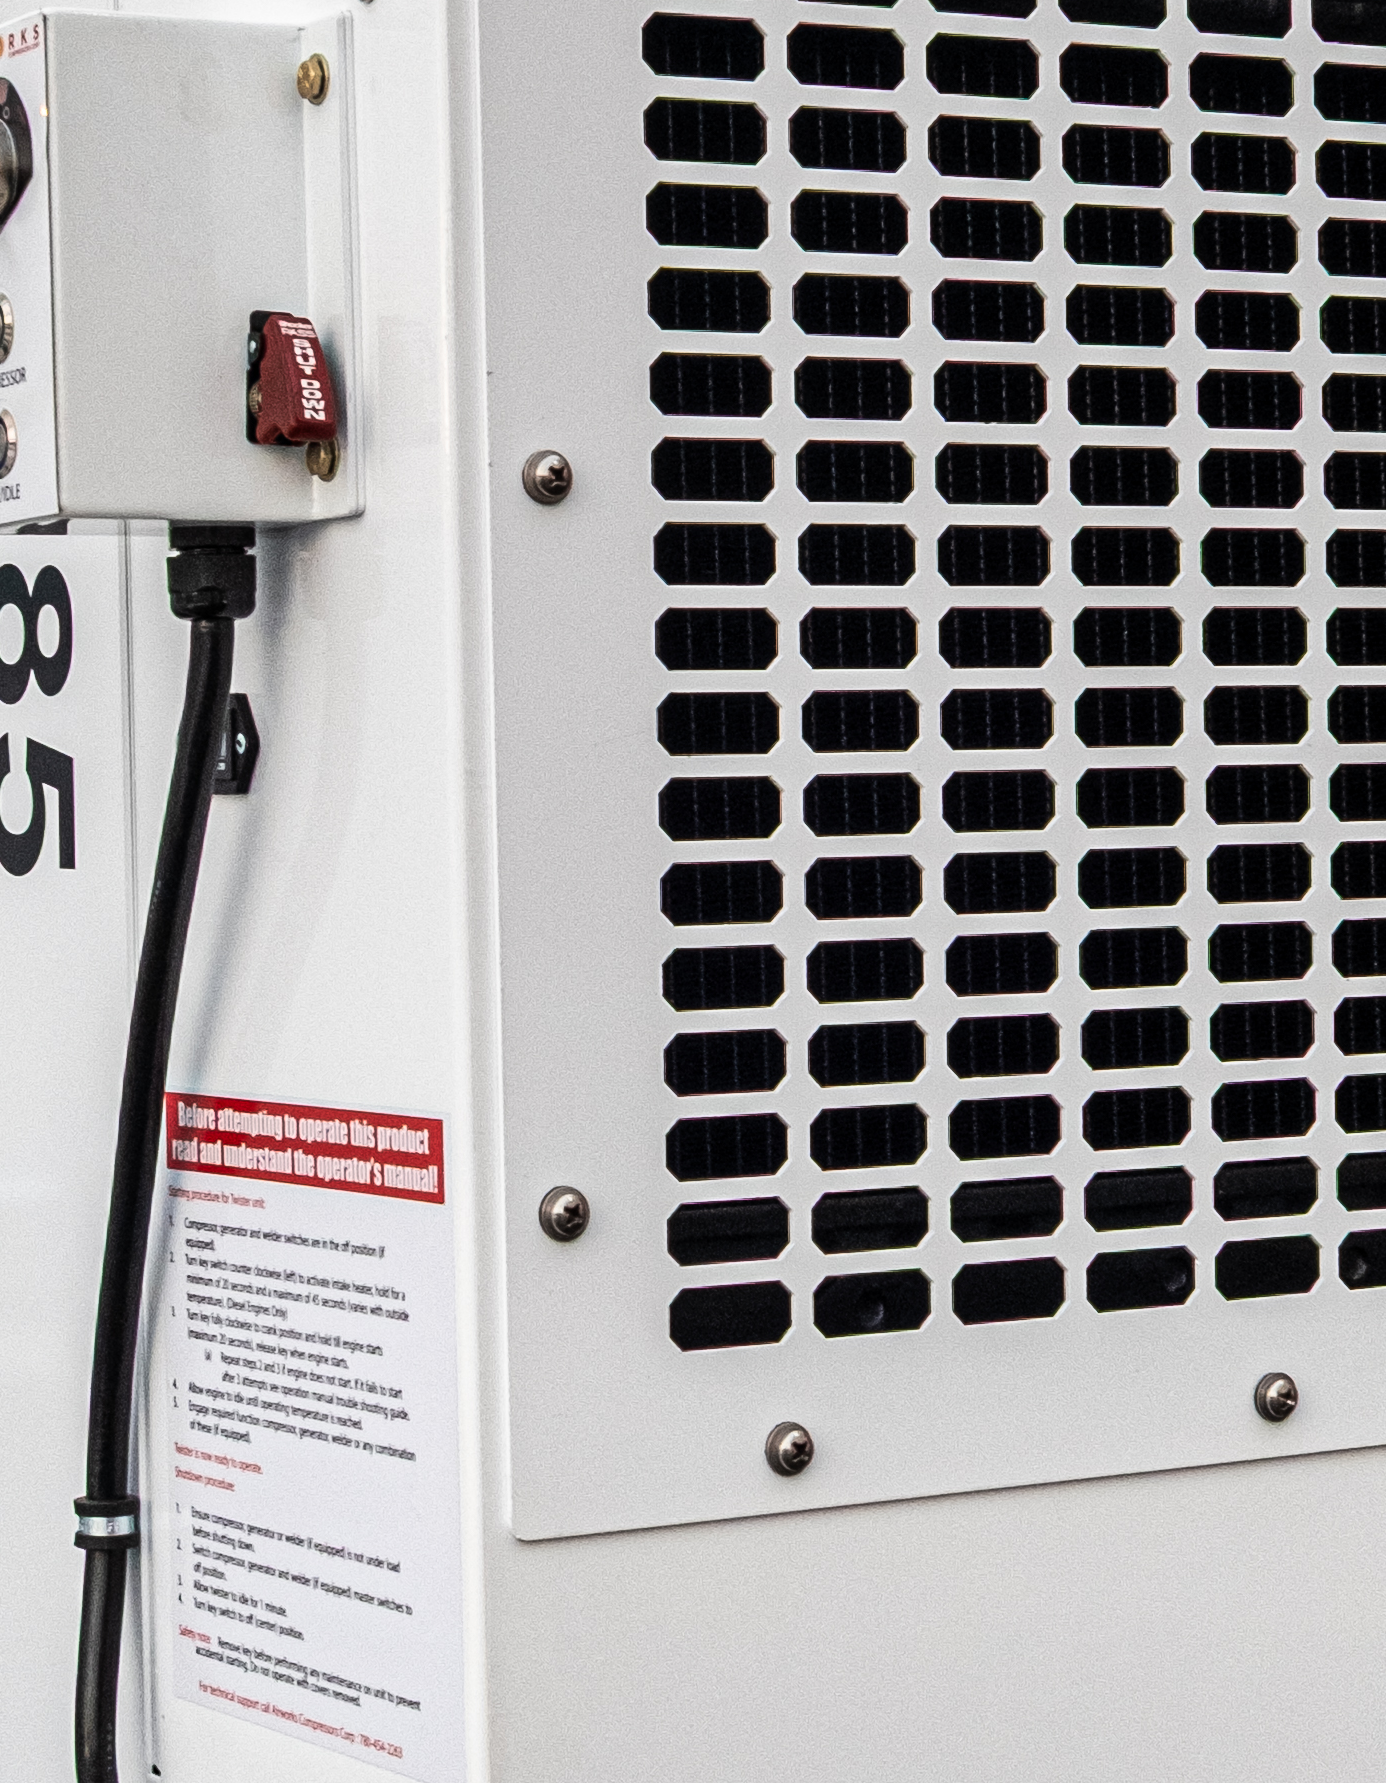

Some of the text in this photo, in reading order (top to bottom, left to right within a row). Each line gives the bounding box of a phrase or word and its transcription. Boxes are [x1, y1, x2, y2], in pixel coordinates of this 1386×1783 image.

[300, 378, 326, 421] DOWN
[177, 1101, 429, 1155] Before attempting to operate this product
[171, 1137, 197, 1162] read
[199, 1138, 221, 1166] and
[223, 1142, 292, 1175] understand
[293, 1148, 314, 1177] the
